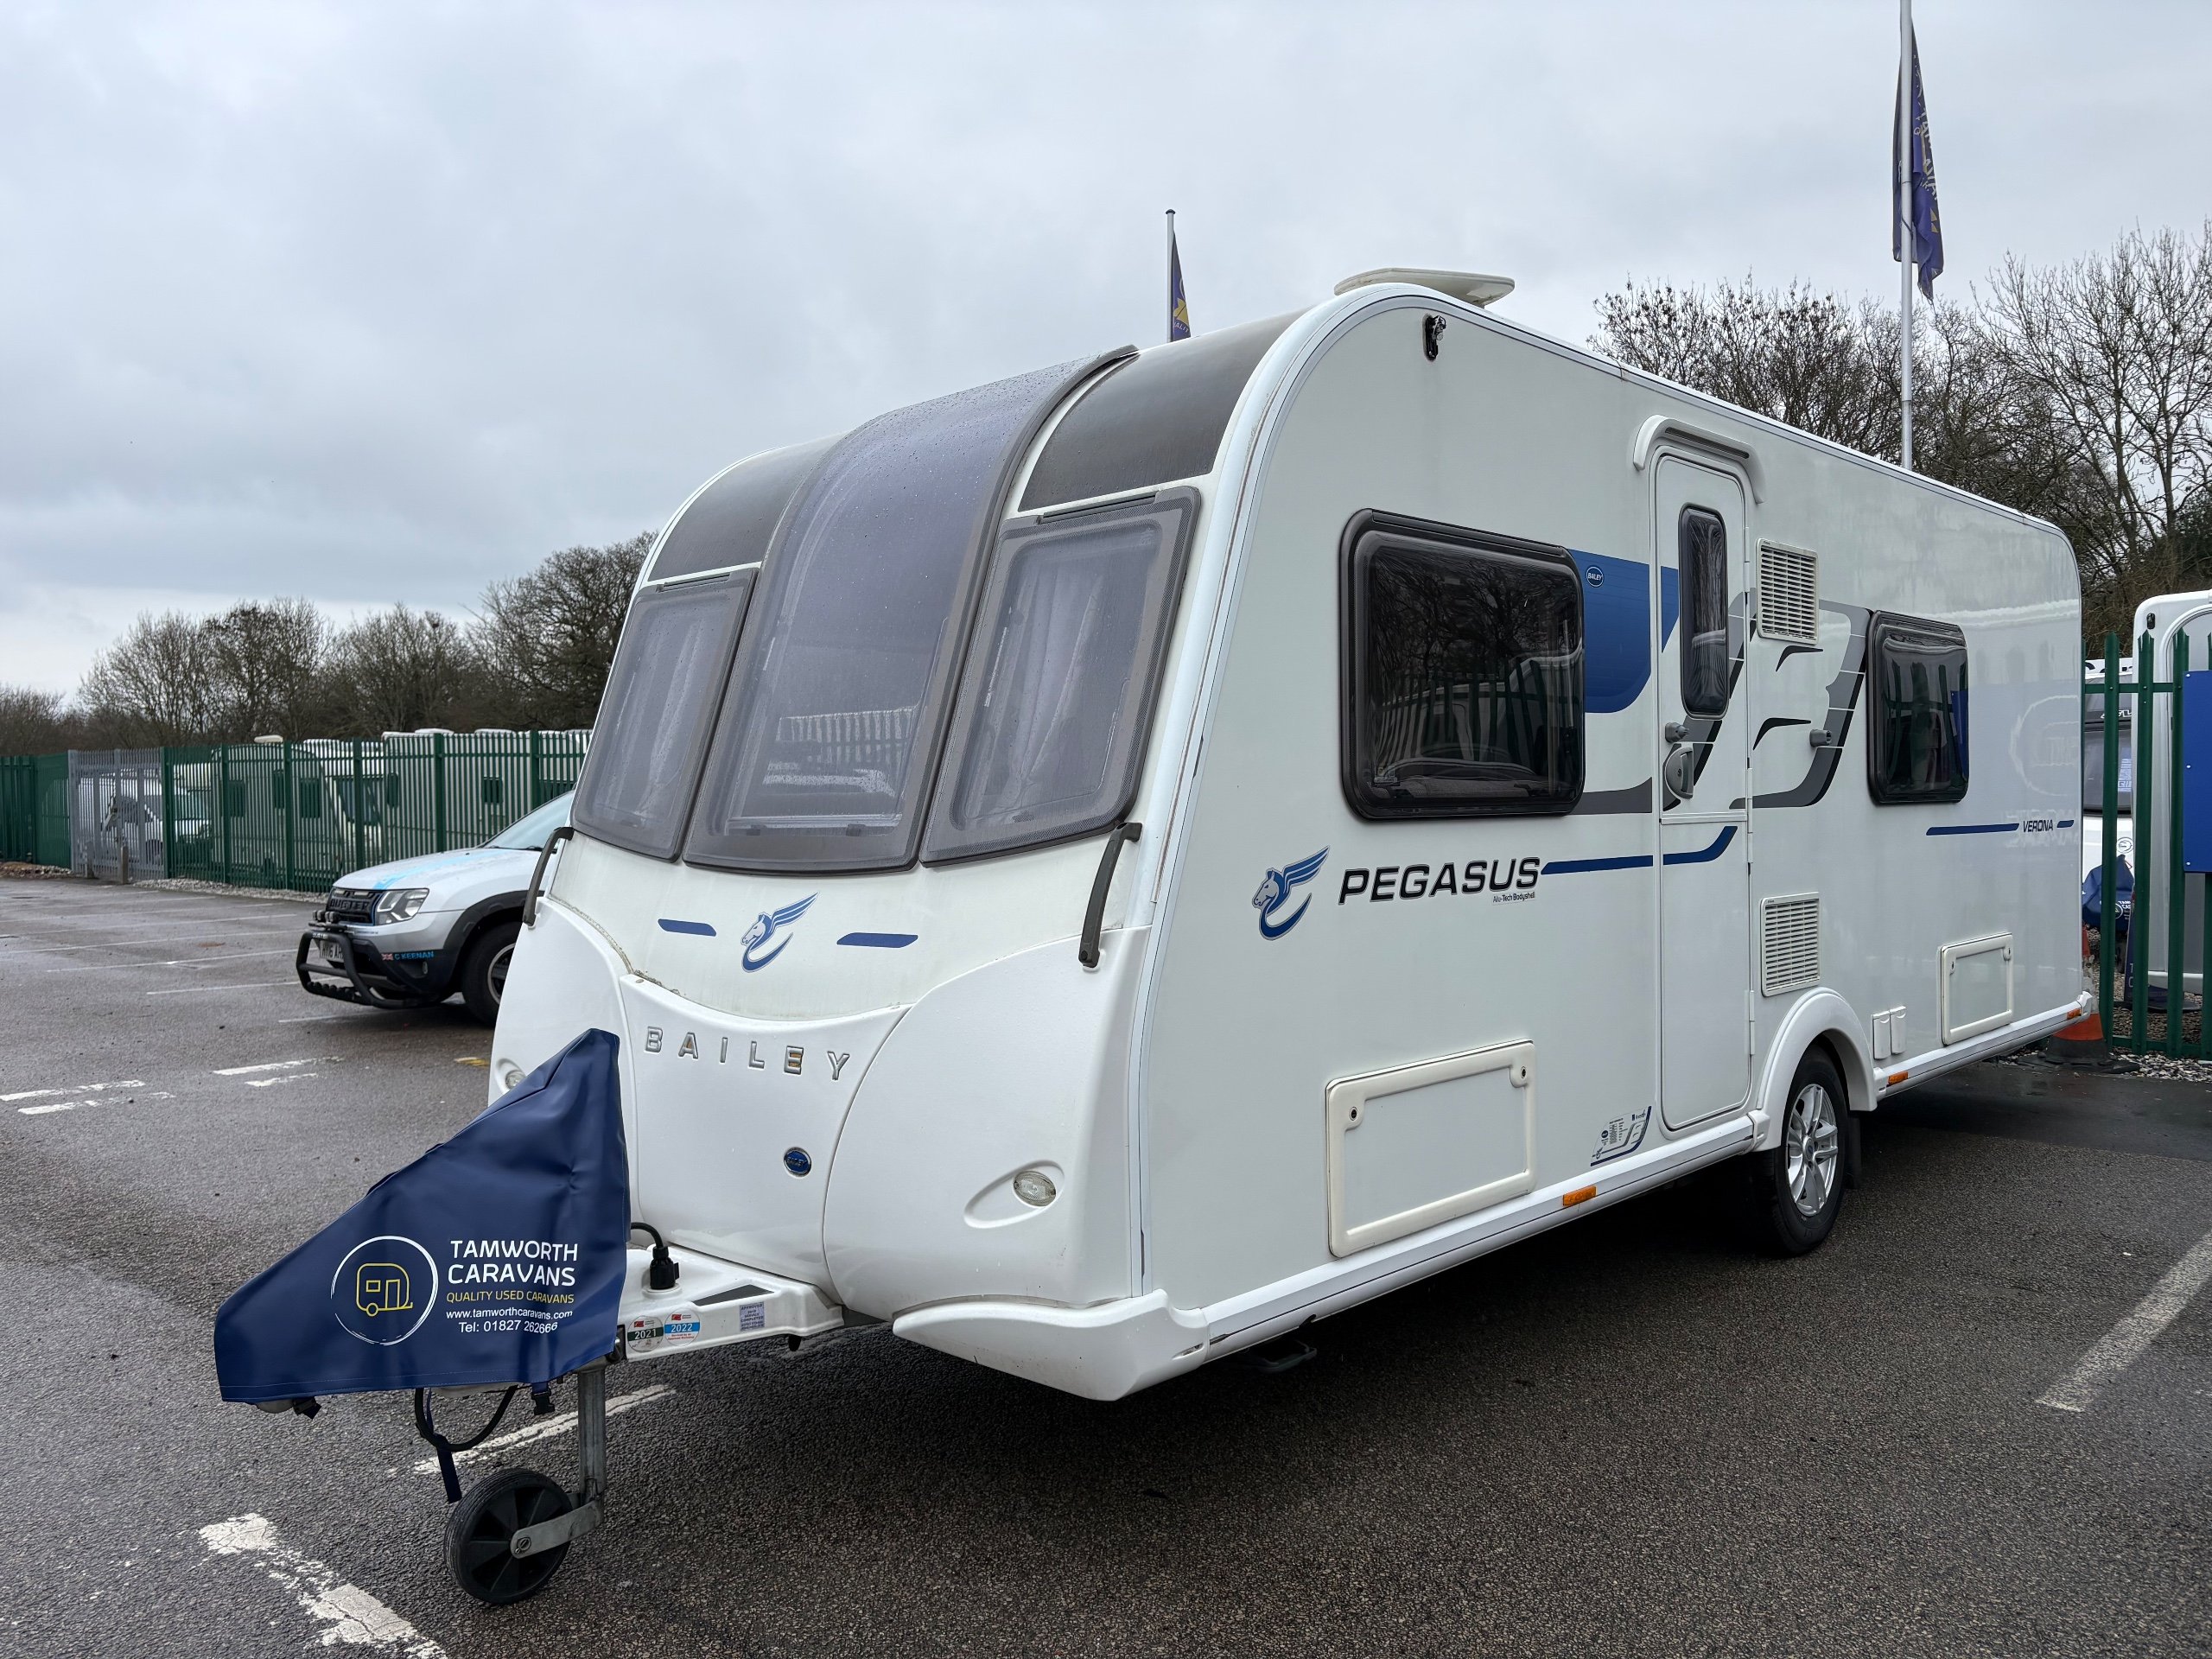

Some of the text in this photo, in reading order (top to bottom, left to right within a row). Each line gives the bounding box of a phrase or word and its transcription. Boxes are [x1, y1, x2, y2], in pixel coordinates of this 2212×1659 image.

[1587, 572, 1602, 581] BAILEY
[2023, 819, 2054, 833] VERONA
[1338, 856, 1541, 906] PEGASUS
[1513, 891, 1535, 901] Bodyshell
[329, 898, 370, 911] DUSTER
[401, 950, 435, 960] KEENAN
[644, 1024, 851, 1081] BAILEY
[450, 1240, 578, 1262] TAMWORTH
[448, 1263, 575, 1287] CARAVANS
[446, 1290, 575, 1304] QUALITY USED CARAVANS
[445, 1306, 573, 1320] www.tamworthcaravans.com
[458, 1319, 558, 1334] Tel: 01827 262666
[671, 1323, 693, 1332] 2022
[634, 1328, 657, 1340] 2021
